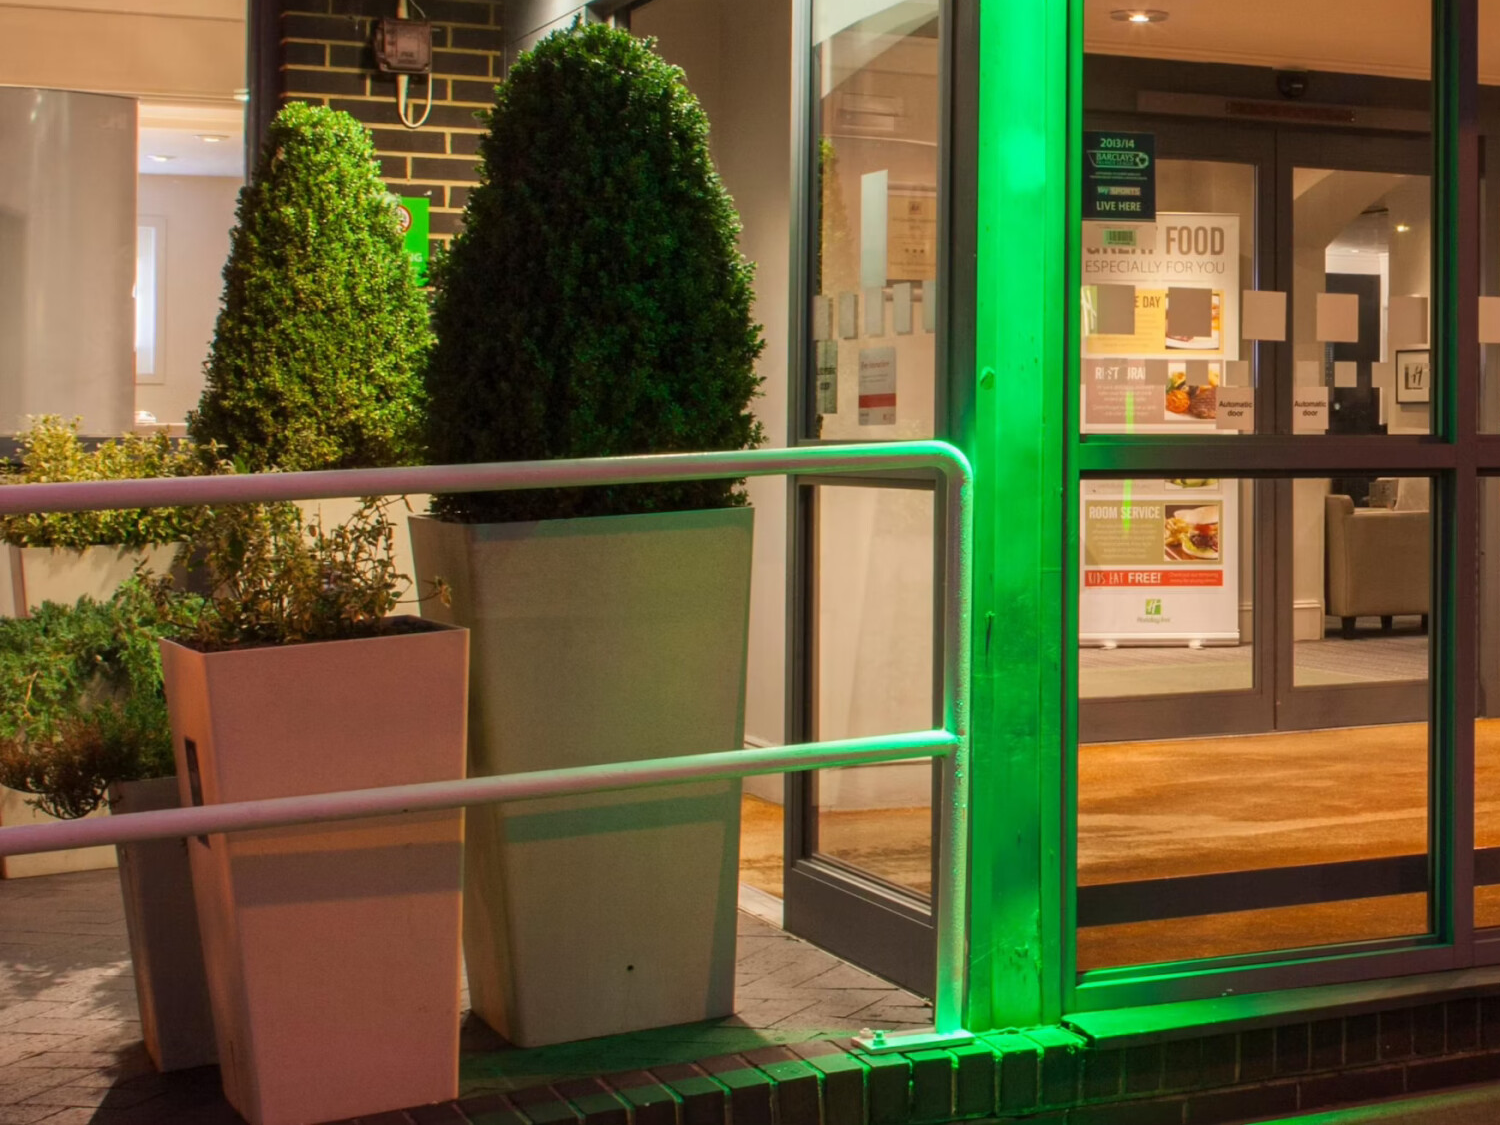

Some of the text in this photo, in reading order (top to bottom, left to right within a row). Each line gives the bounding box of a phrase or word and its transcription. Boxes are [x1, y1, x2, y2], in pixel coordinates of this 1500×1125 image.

[1100, 138, 1135, 148] 2013/14
[1096, 152, 1134, 161] BARCLAYS
[1096, 201, 1142, 211] LIVE HERE
[1166, 226, 1225, 255] FOOD
[1085, 260, 1225, 274] ESPECIALLY FOR YOU
[1142, 296, 1160, 308] DAY
[1219, 400, 1252, 408] Automatic
[1294, 400, 1326, 408] Automatic
[1089, 506, 1161, 519] ROOM SERVICE
[1088, 572, 1106, 584] KIDS
[1109, 572, 1124, 584] EAT
[1127, 572, 1162, 584] FREE!
